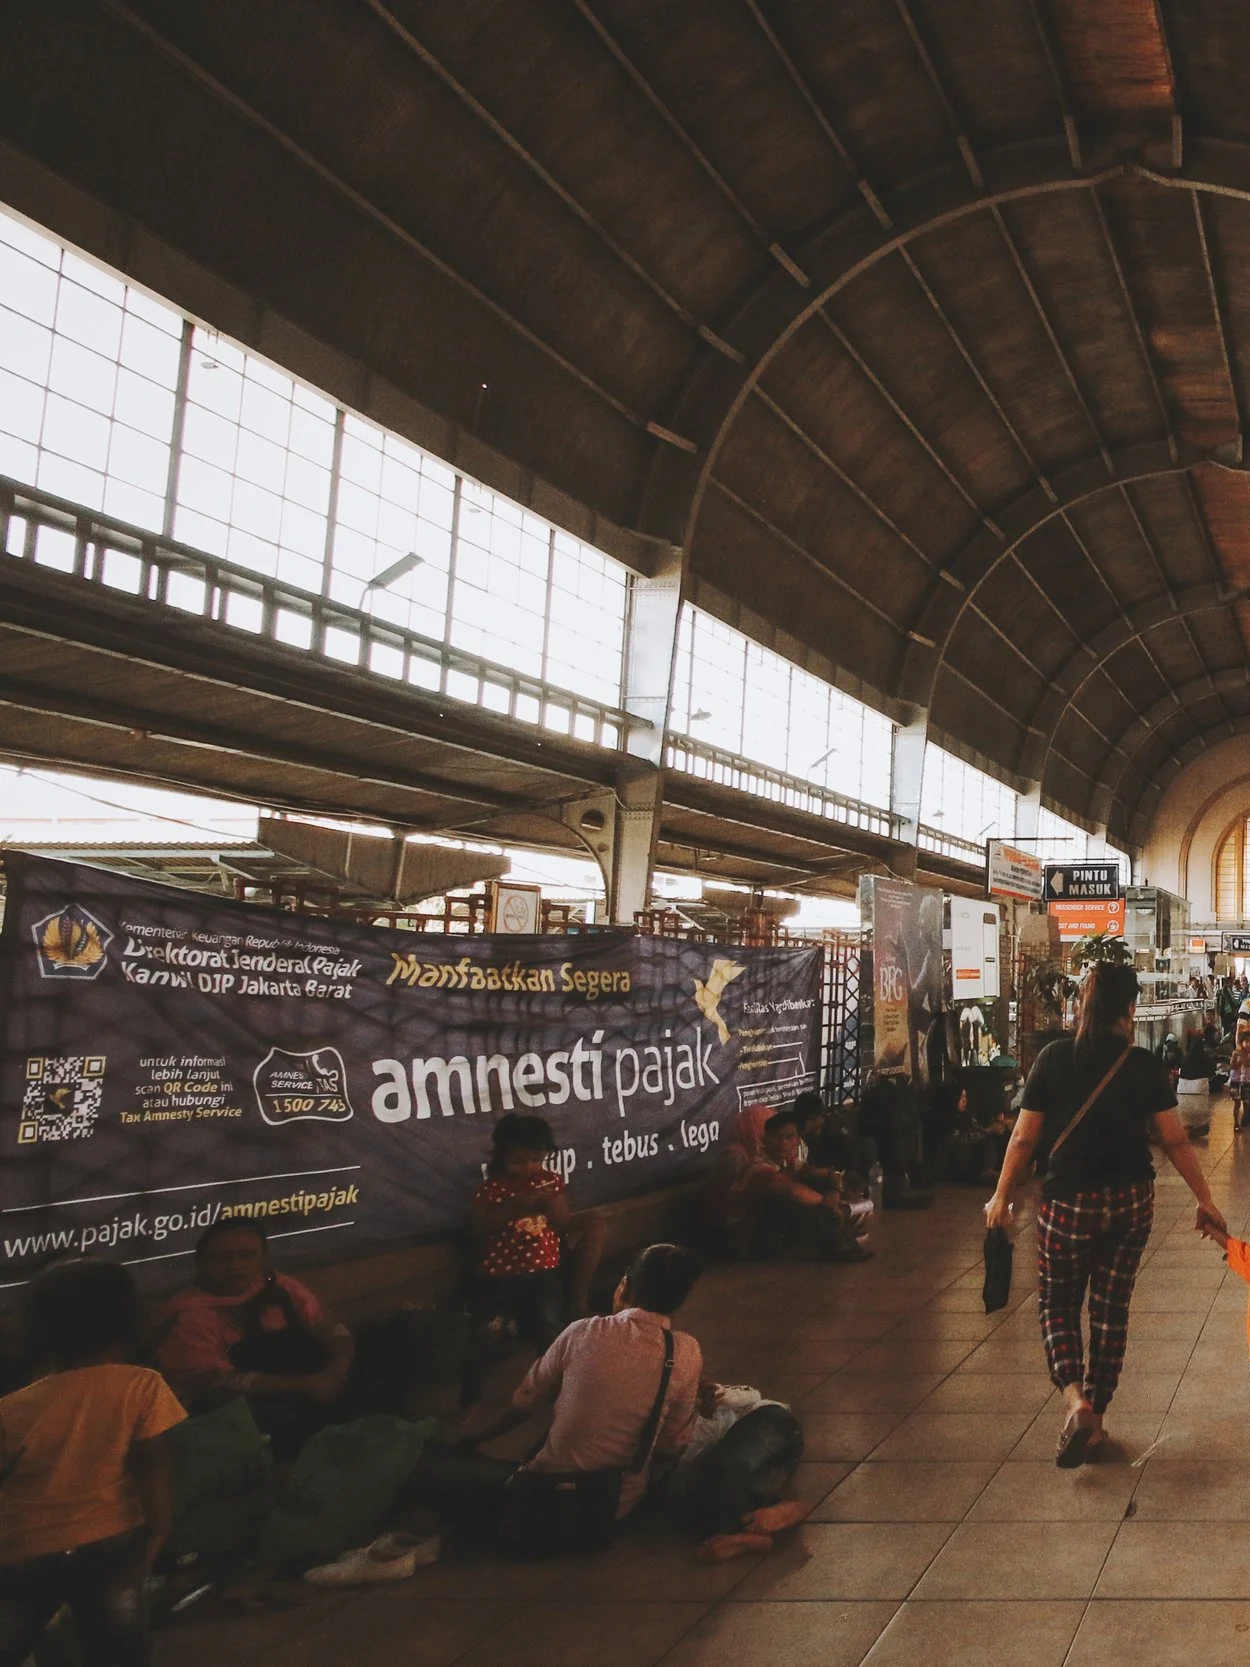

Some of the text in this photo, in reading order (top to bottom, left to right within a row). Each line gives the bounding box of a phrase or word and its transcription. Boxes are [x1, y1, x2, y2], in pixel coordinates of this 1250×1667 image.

[1073, 869, 1108, 882] PINTU
[1069, 883, 1111, 895] MASUK
[192, 930, 243, 948] Keuangan
[230, 949, 311, 974] Jenderal
[312, 956, 363, 980] Pajak
[120, 960, 352, 999] Kanwil DJP Jakarta Barat
[385, 952, 630, 1000] Manfaatkan Segera
[140, 1054, 226, 1068] untuk informasi
[151, 1068, 220, 1083] lebih lanjut
[372, 1026, 720, 1124] amnesti pajak
[135, 1081, 234, 1096] scan QR Code ini
[271, 1080, 313, 1090] SERVICE
[142, 1094, 226, 1109] atau hubungi
[119, 1107, 243, 1124] Tax Amnesty Service
[602, 1130, 659, 1166] tebus
[680, 1119, 720, 1153] lega
[3, 1184, 359, 1259] www.pajak.go.id/amnestipajak
